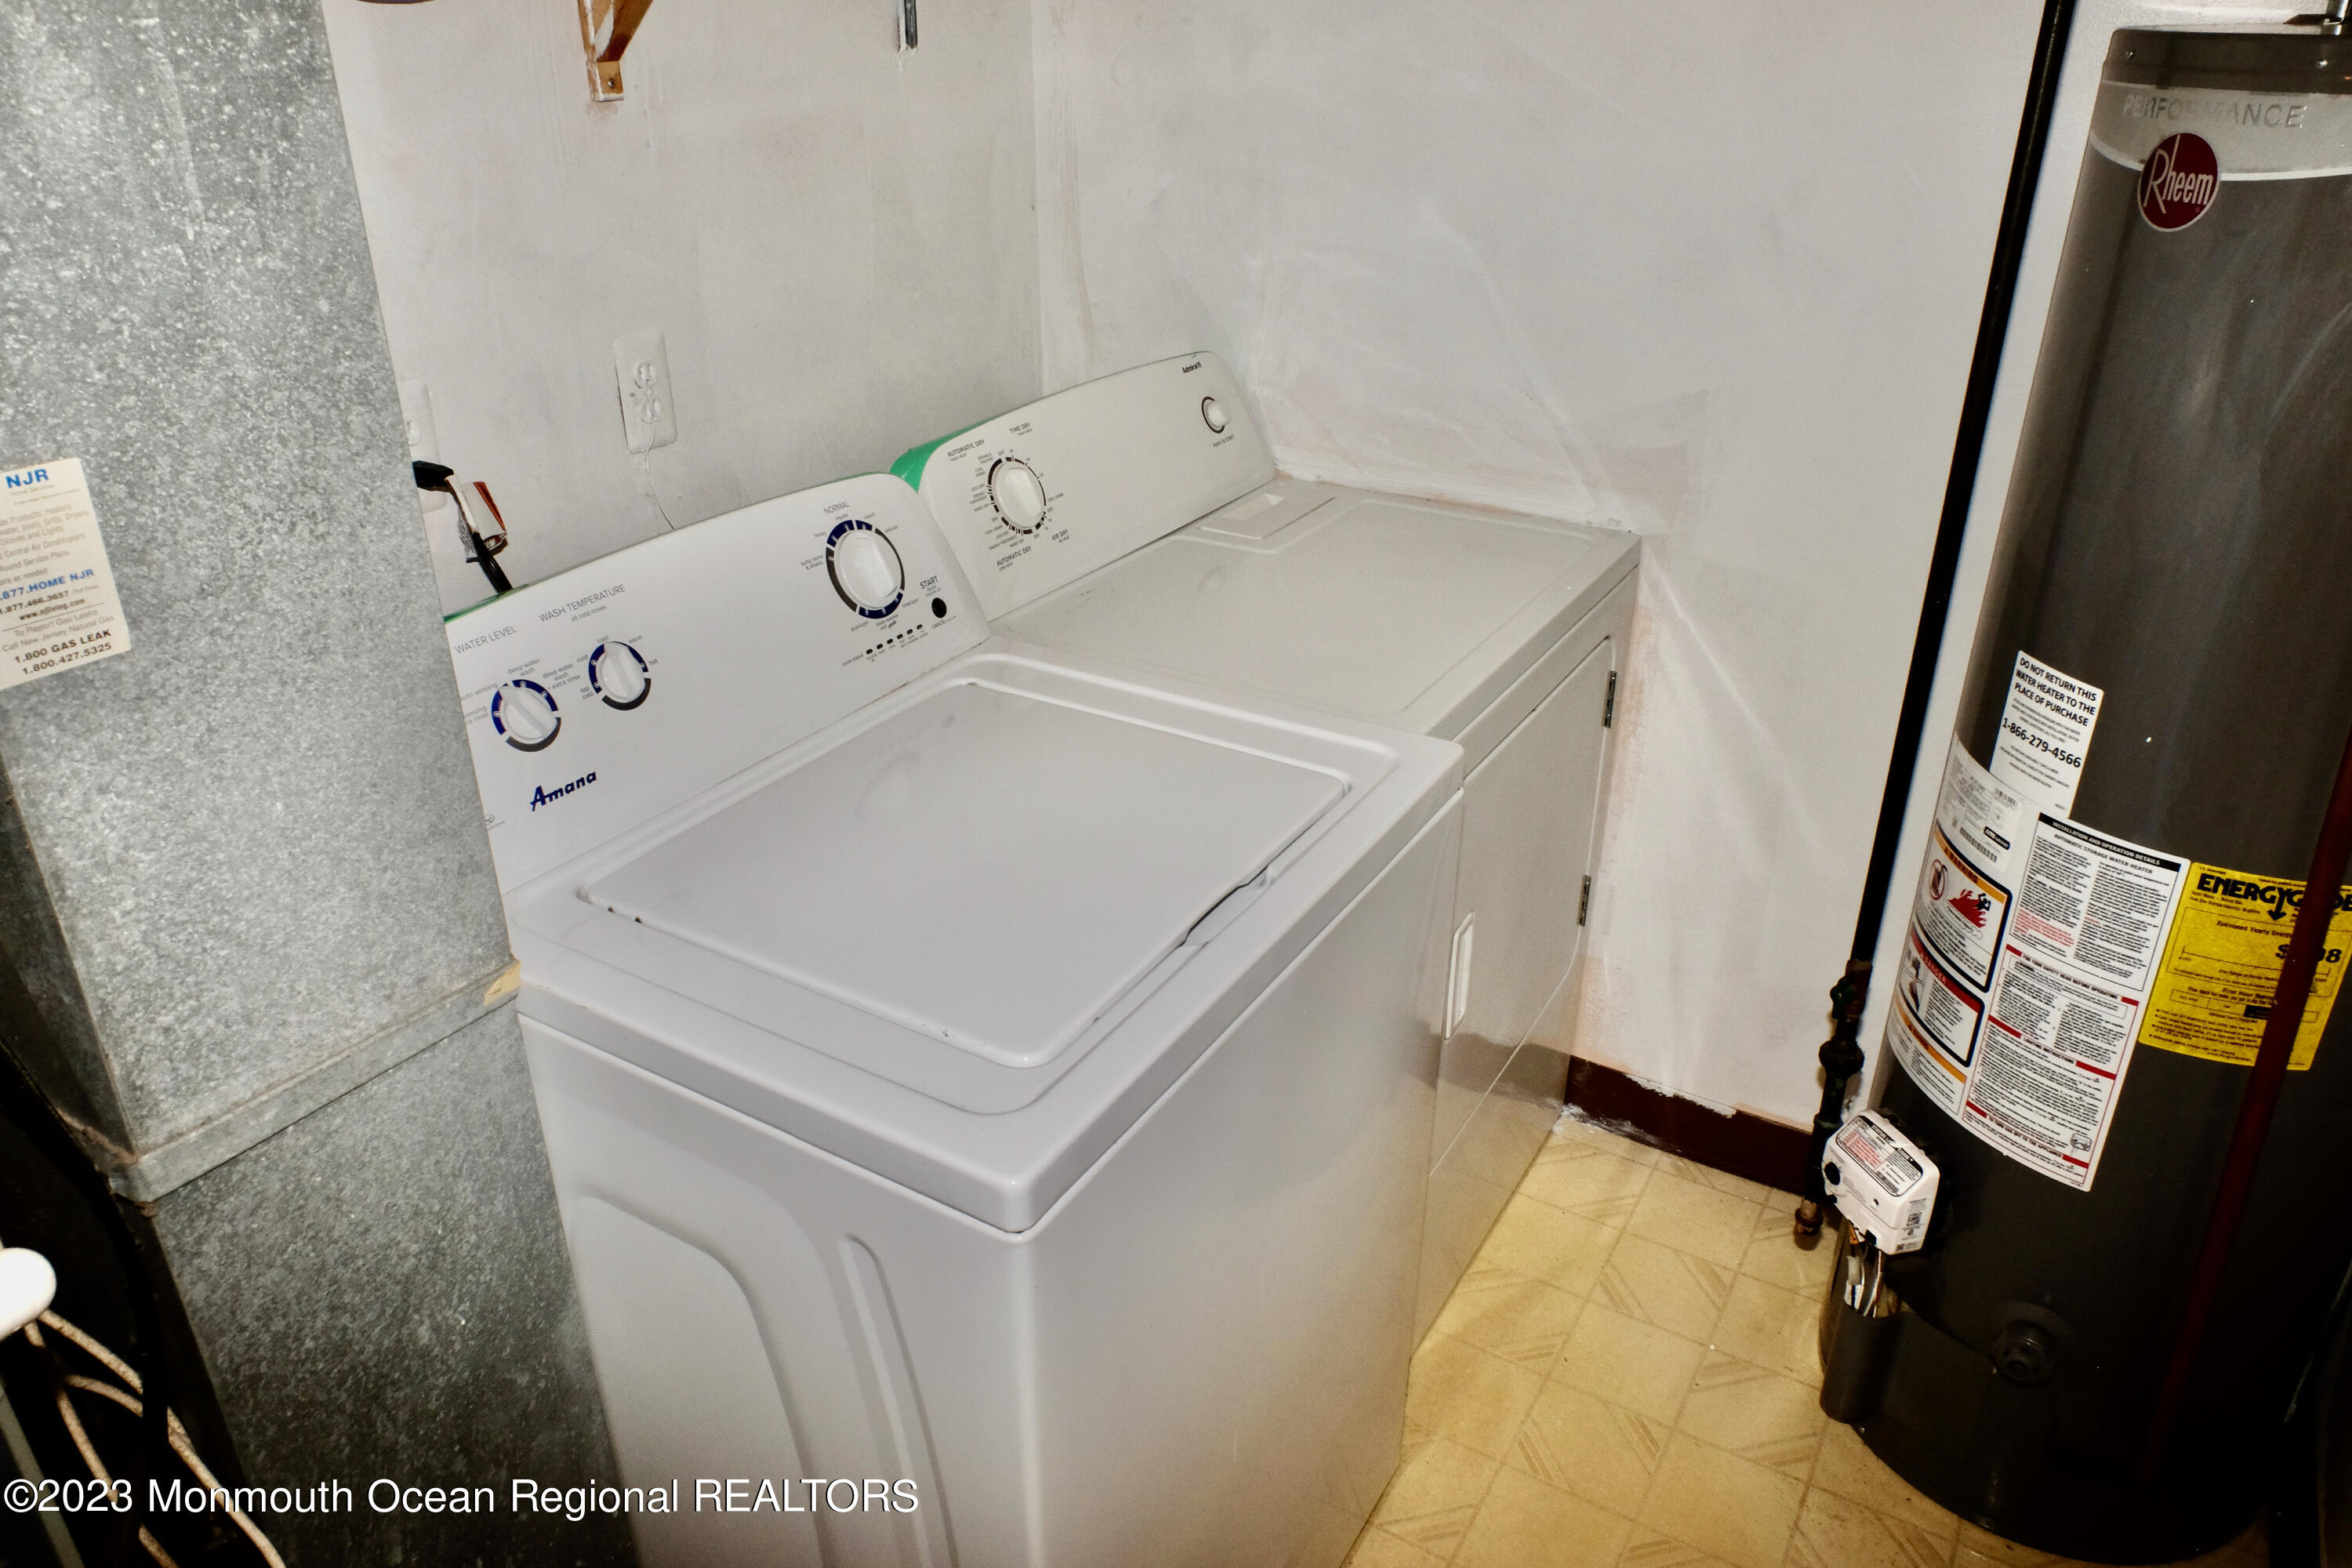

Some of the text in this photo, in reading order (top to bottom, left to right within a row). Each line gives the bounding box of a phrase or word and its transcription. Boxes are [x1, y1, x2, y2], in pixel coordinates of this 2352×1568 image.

[2143, 134, 2213, 214] Rheem
[1010, 425, 1022, 434] TIME
[947, 442, 975, 457] AUTOMATIC
[5, 469, 49, 488] NJR
[823, 502, 851, 514] NORMAL
[1059, 528, 1069, 537] DRY
[996, 545, 1032, 566] AUTOMATIC DRY
[69, 568, 94, 582] NJR
[920, 575, 939, 589] START
[539, 584, 626, 623] WASH TEMPERATURE
[26, 621, 54, 633] Report
[56, 616, 73, 626] Gas
[74, 609, 98, 620] Leaks
[579, 610, 591, 620] cold
[2, 615, 115, 652] Call New Jersey Natural Gas
[454, 626, 518, 654] WATER LEVEL
[597, 635, 609, 644] cool
[15, 629, 111, 663] 1.800 GAS LEAK
[23, 642, 111, 674] 1.800.427.5325
[508, 659, 540, 675] deep water
[576, 654, 590, 663] cold
[519, 667, 536, 677] wash
[543, 662, 574, 680] deep water
[554, 672, 569, 682] wash
[2020, 657, 2098, 702] DO NOT RETURN THIS
[552, 674, 582, 690] extra rinse
[581, 691, 594, 701] cold
[2016, 670, 2097, 716] WATER HEATER TO THE
[2015, 682, 2089, 726] PLACE OF PURCHASE
[2002, 717, 2082, 768] 1-866-279-4566
[530, 771, 597, 812] Amana
[2053, 822, 2161, 866] INSTALLATION AND OPERATION DETAILS
[2053, 833, 2154, 874] AUTOMATIC STORAGE WATER HEATER
[2217, 920, 2249, 931] Estimated
[2250, 926, 2270, 936] Yearly
[1924, 956, 1946, 985] DANGER
[2043, 965, 2059, 975] SAFETY
[2222, 987, 2237, 996] First
